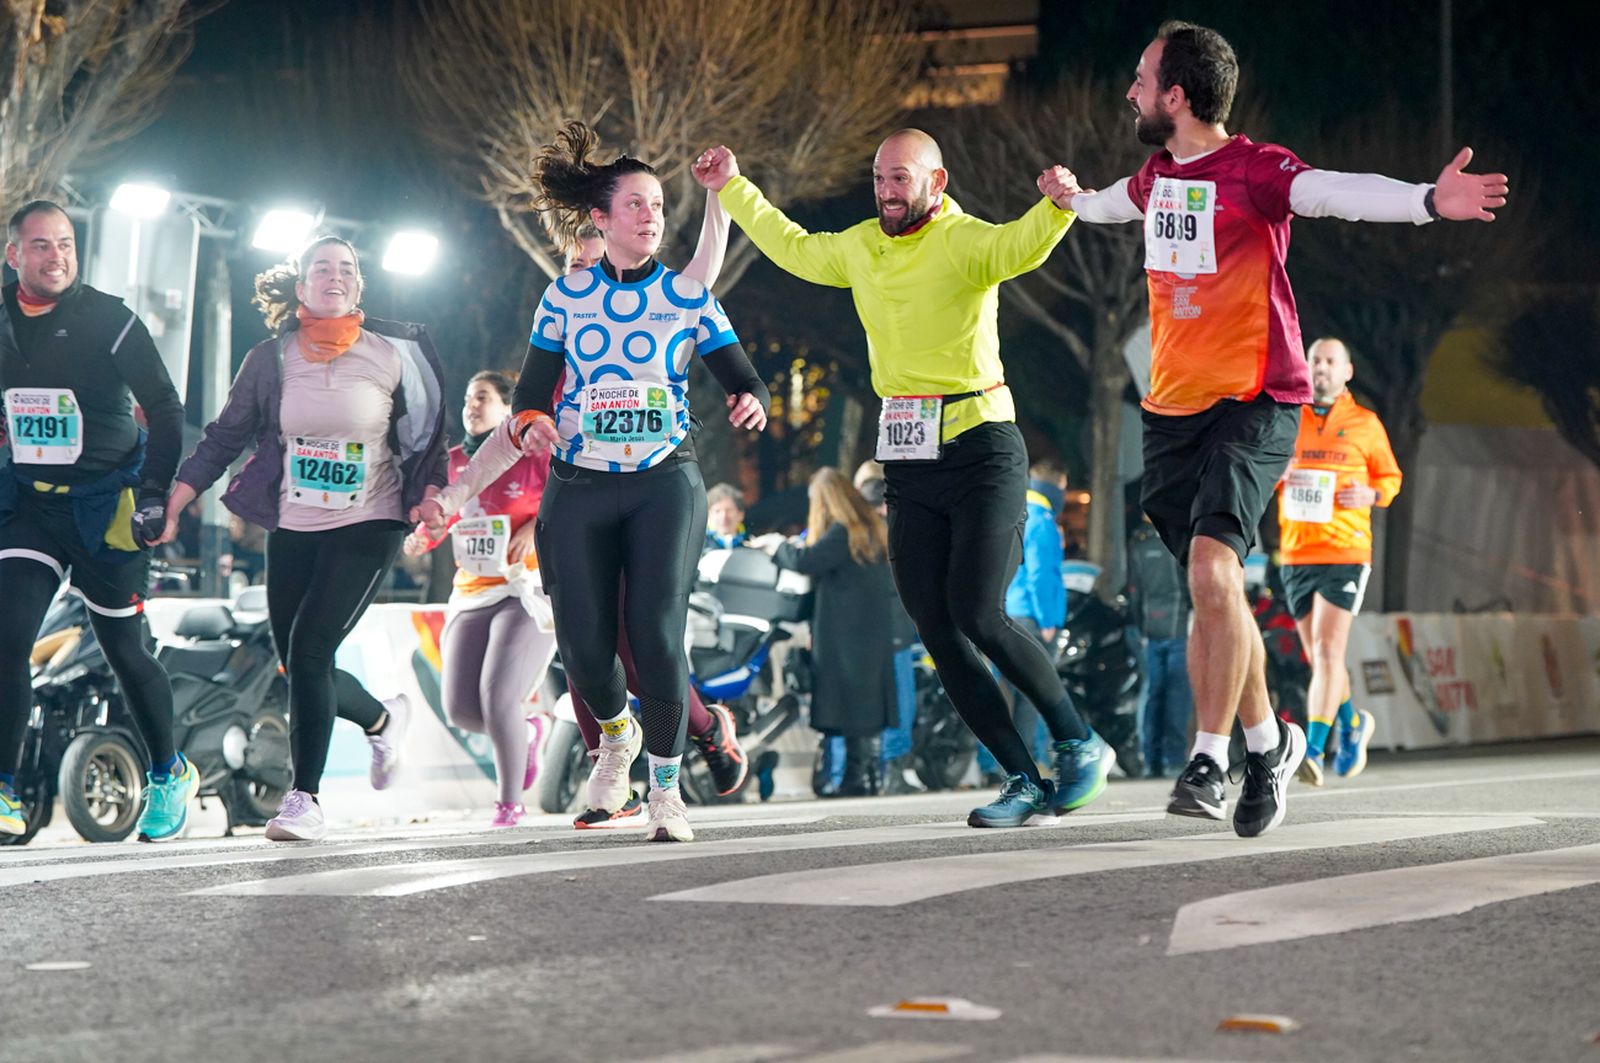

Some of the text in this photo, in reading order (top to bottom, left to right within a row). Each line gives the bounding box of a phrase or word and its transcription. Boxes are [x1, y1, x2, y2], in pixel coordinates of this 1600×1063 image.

[599, 389, 640, 400] NOCHE DE
[591, 401, 607, 412] SAN
[15, 416, 68, 439] 12191
[593, 409, 663, 434] 12376
[886, 421, 926, 446] 1023
[296, 447, 312, 456] SAN
[306, 440, 340, 451] NOCHE DE
[297, 458, 358, 485] 12462
[466, 537, 495, 556] 1749
